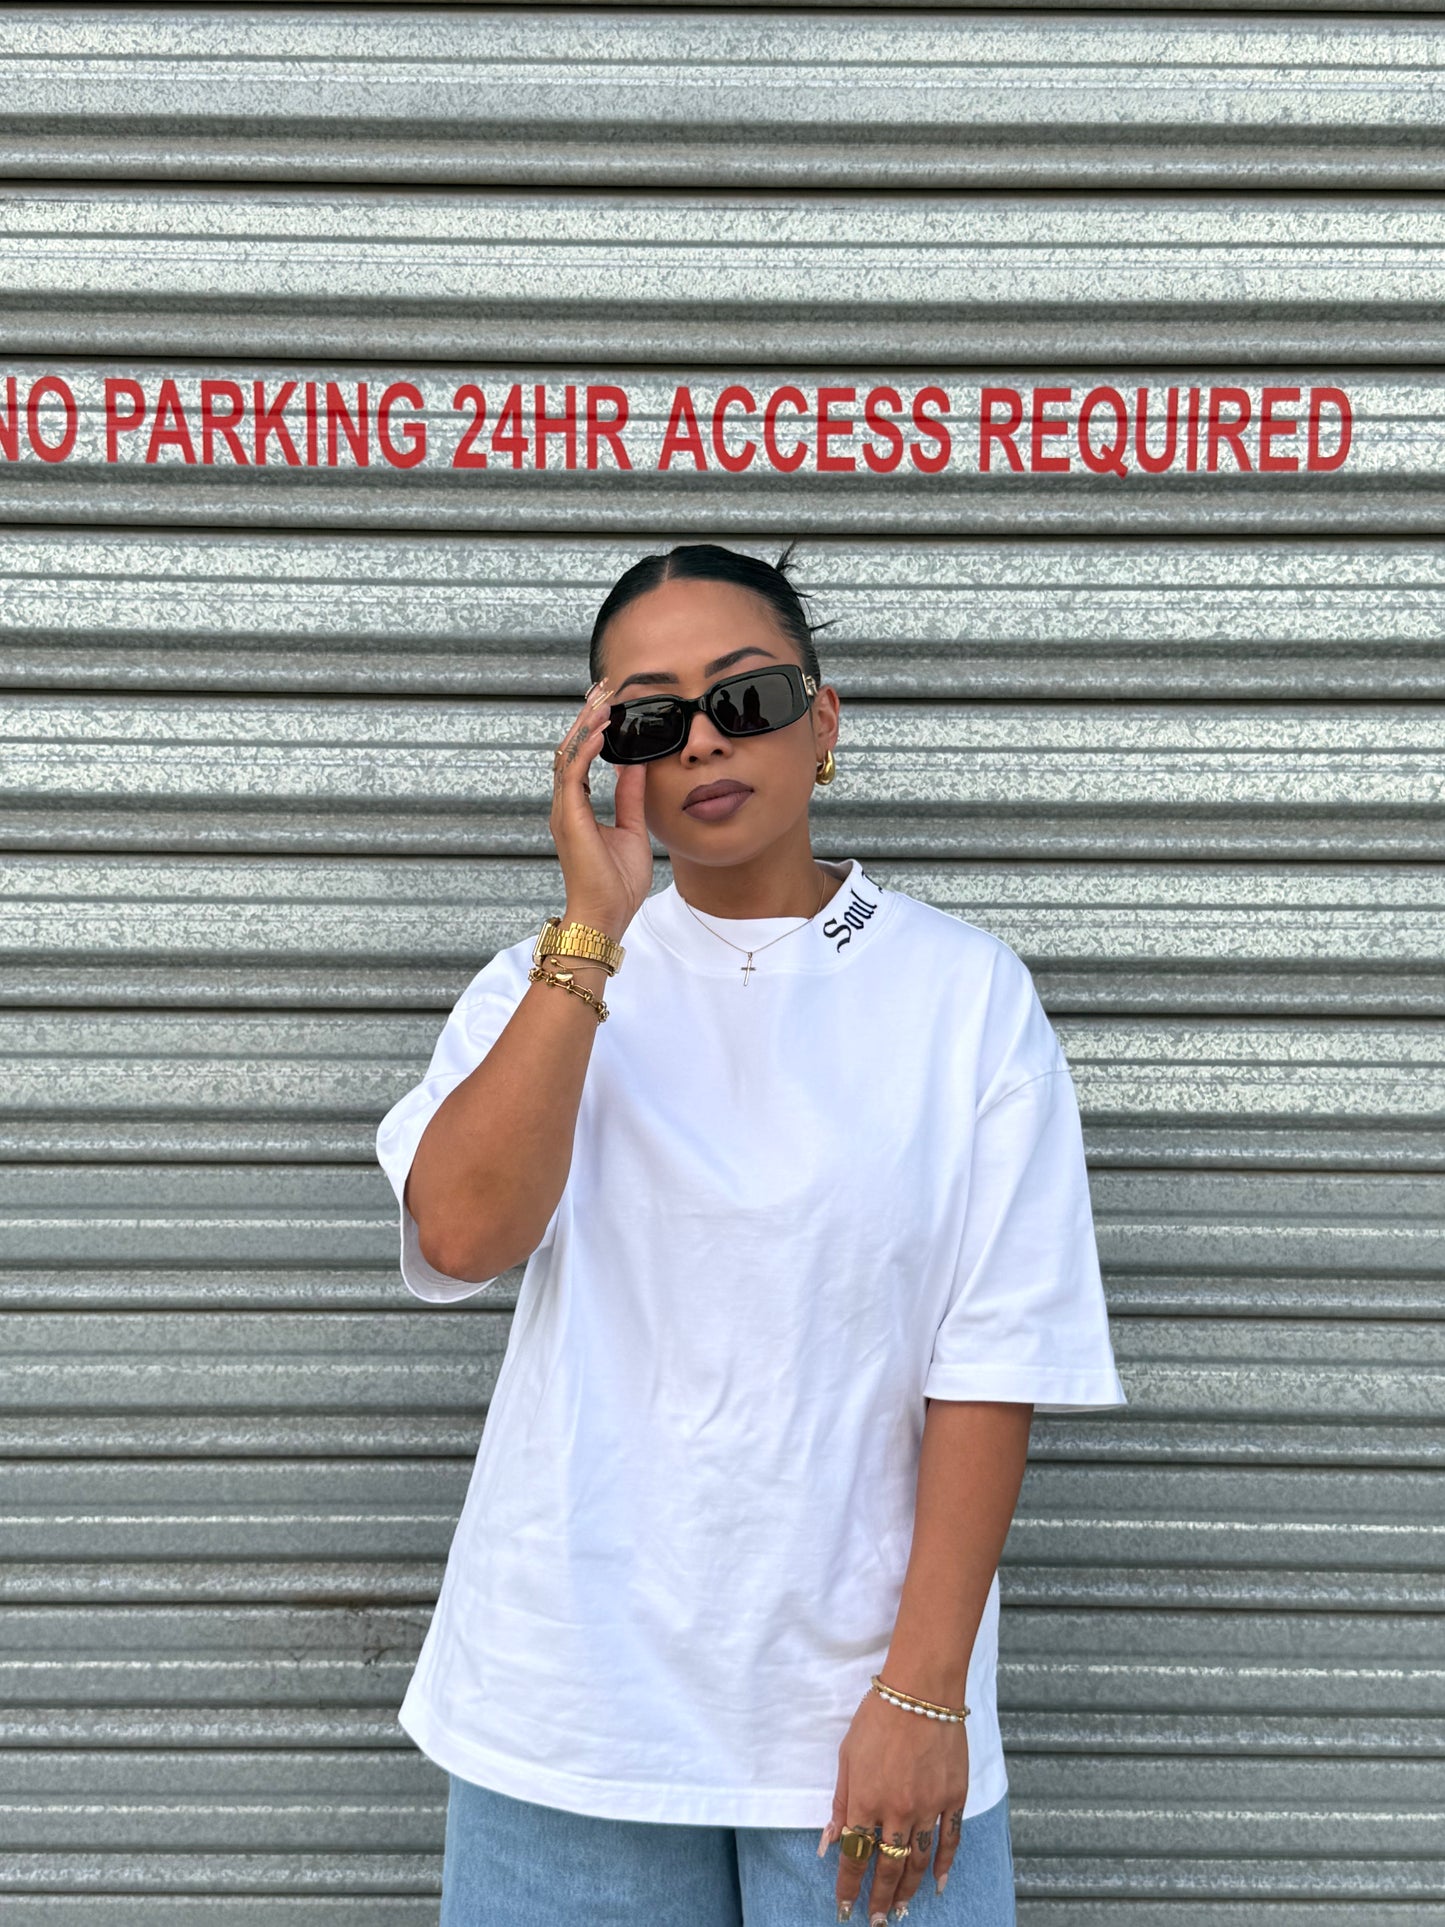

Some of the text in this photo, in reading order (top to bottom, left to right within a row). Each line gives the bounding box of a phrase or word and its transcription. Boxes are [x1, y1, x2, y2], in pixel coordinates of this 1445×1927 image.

[104, 377, 426, 470] PARKING
[452, 384, 632, 471] 24HR
[657, 385, 952, 475] ACCESS
[979, 386, 1353, 481] REQUIRED
[822, 887, 878, 954] Soul
